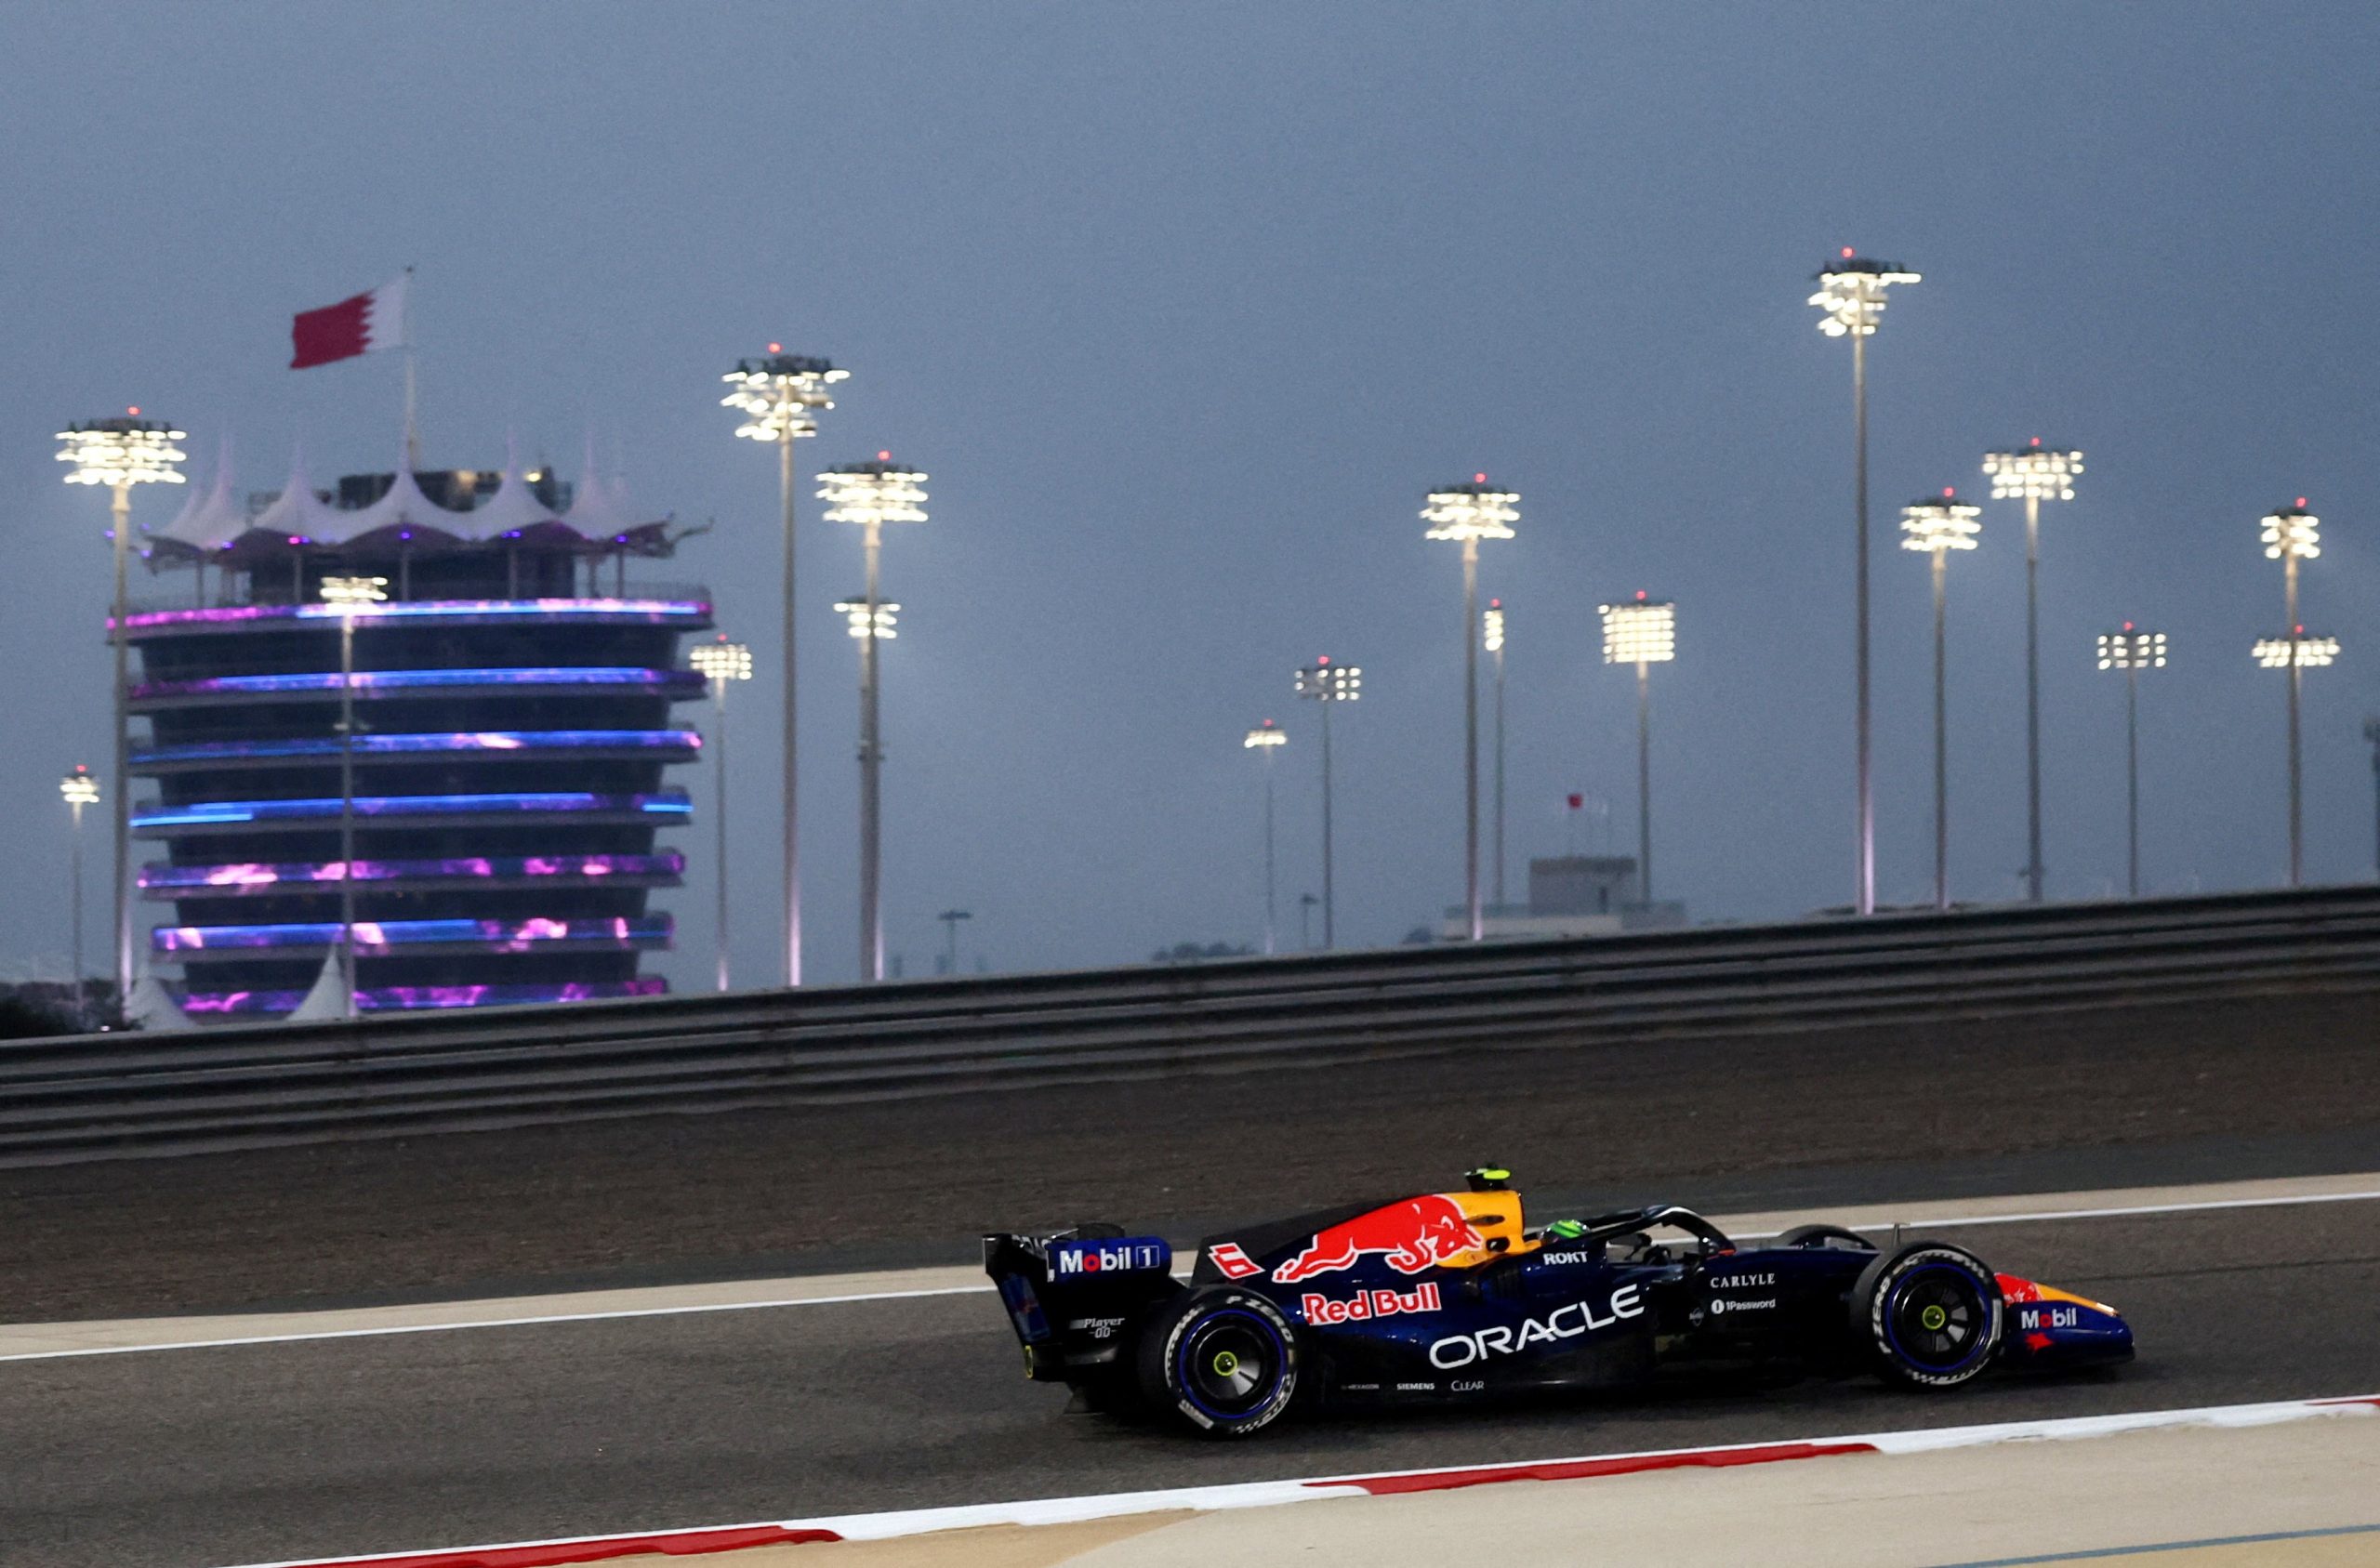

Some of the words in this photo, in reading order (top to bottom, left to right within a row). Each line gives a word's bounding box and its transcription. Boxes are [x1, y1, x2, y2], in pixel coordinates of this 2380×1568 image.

[1060, 1247, 1130, 1273] Mobil
[1543, 1251, 1588, 1265] ROKT
[1710, 1273, 1775, 1288] CARLYLE
[1302, 1290, 1371, 1325] Red
[1371, 1282, 1442, 1316] Bull
[1726, 1298, 1776, 1311] 1Password
[1083, 1317, 1125, 1329] Player
[1429, 1284, 1645, 1369] ORACLE
[2020, 1308, 2076, 1329] Mobil
